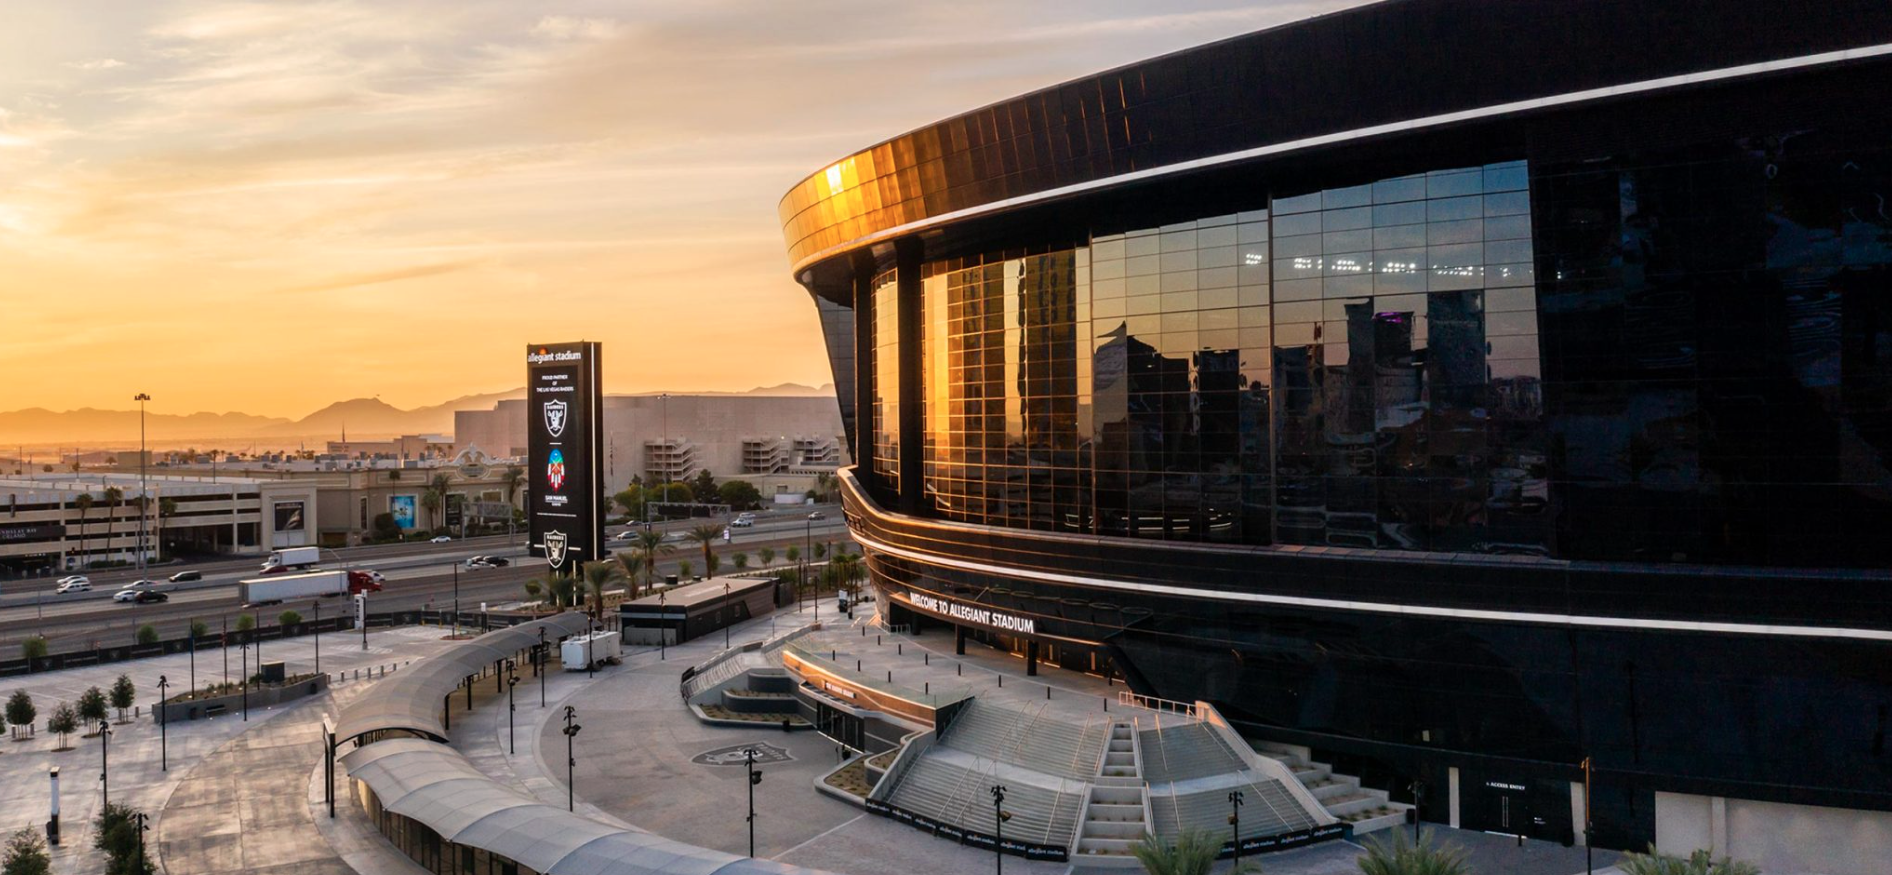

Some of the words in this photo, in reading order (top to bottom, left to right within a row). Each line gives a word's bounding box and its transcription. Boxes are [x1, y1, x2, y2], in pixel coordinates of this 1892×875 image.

[527, 352, 554, 364] allegiant
[555, 350, 582, 361] stadium
[910, 592, 938, 611] WELCOME
[939, 601, 949, 615] TO
[949, 604, 991, 625] ALLEGIANT
[992, 613, 1034, 633] STADIUM
